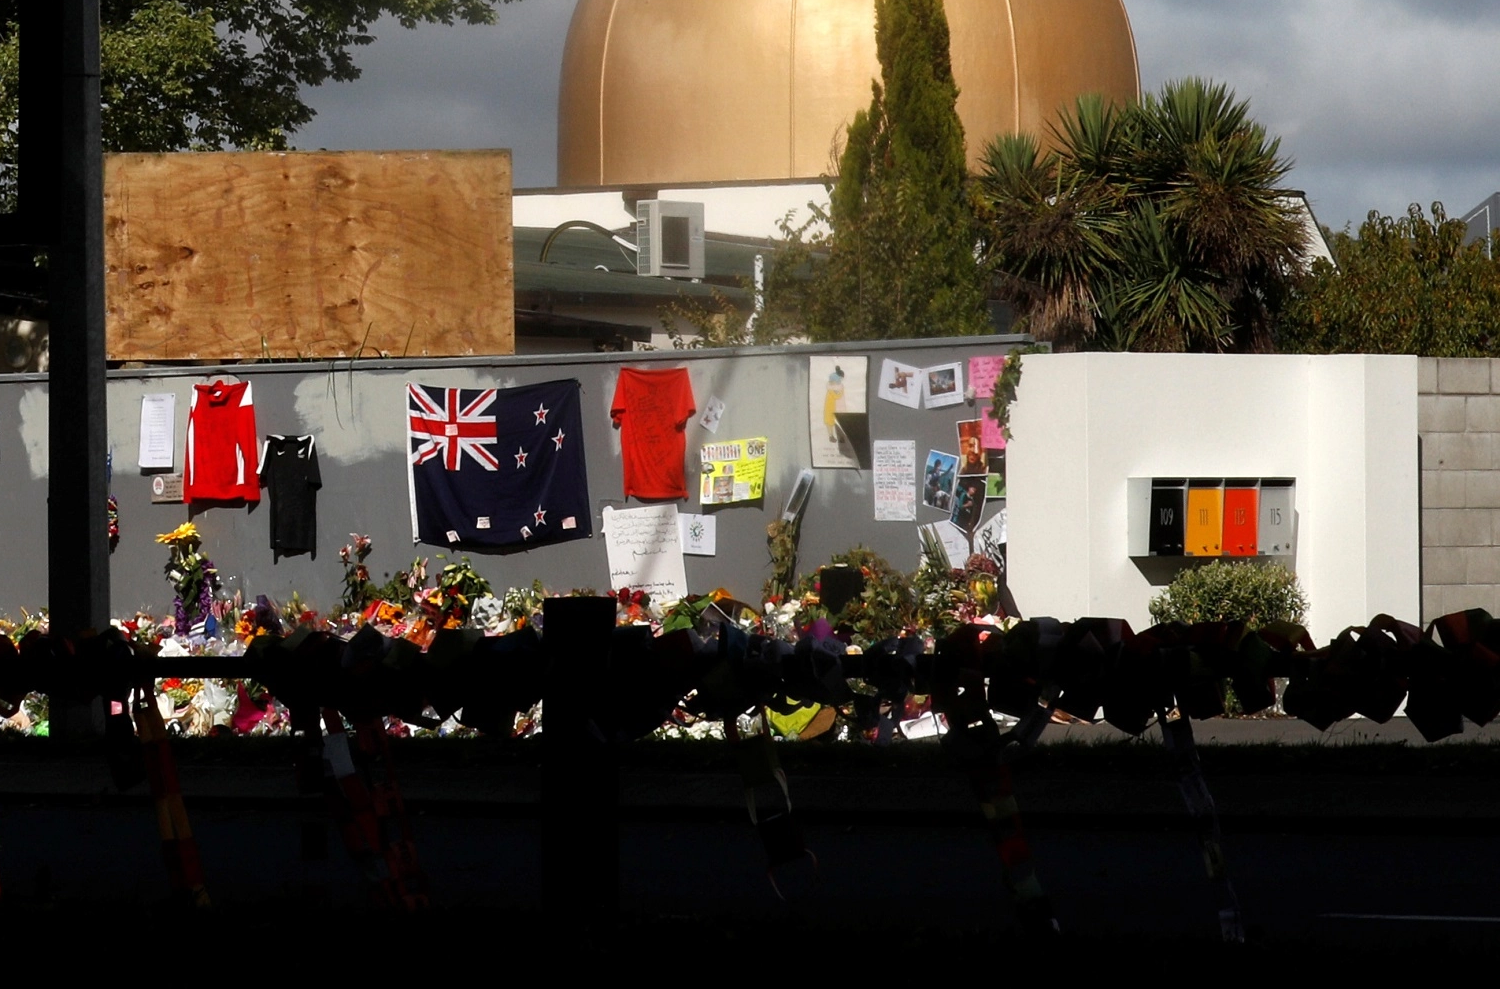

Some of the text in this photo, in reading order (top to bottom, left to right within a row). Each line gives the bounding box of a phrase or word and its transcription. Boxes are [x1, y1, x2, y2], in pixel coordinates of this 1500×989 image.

[748, 445, 765, 455] ONE
[1160, 507, 1174, 526] 109
[1199, 508, 1209, 526] 111
[1270, 507, 1282, 526] 115
